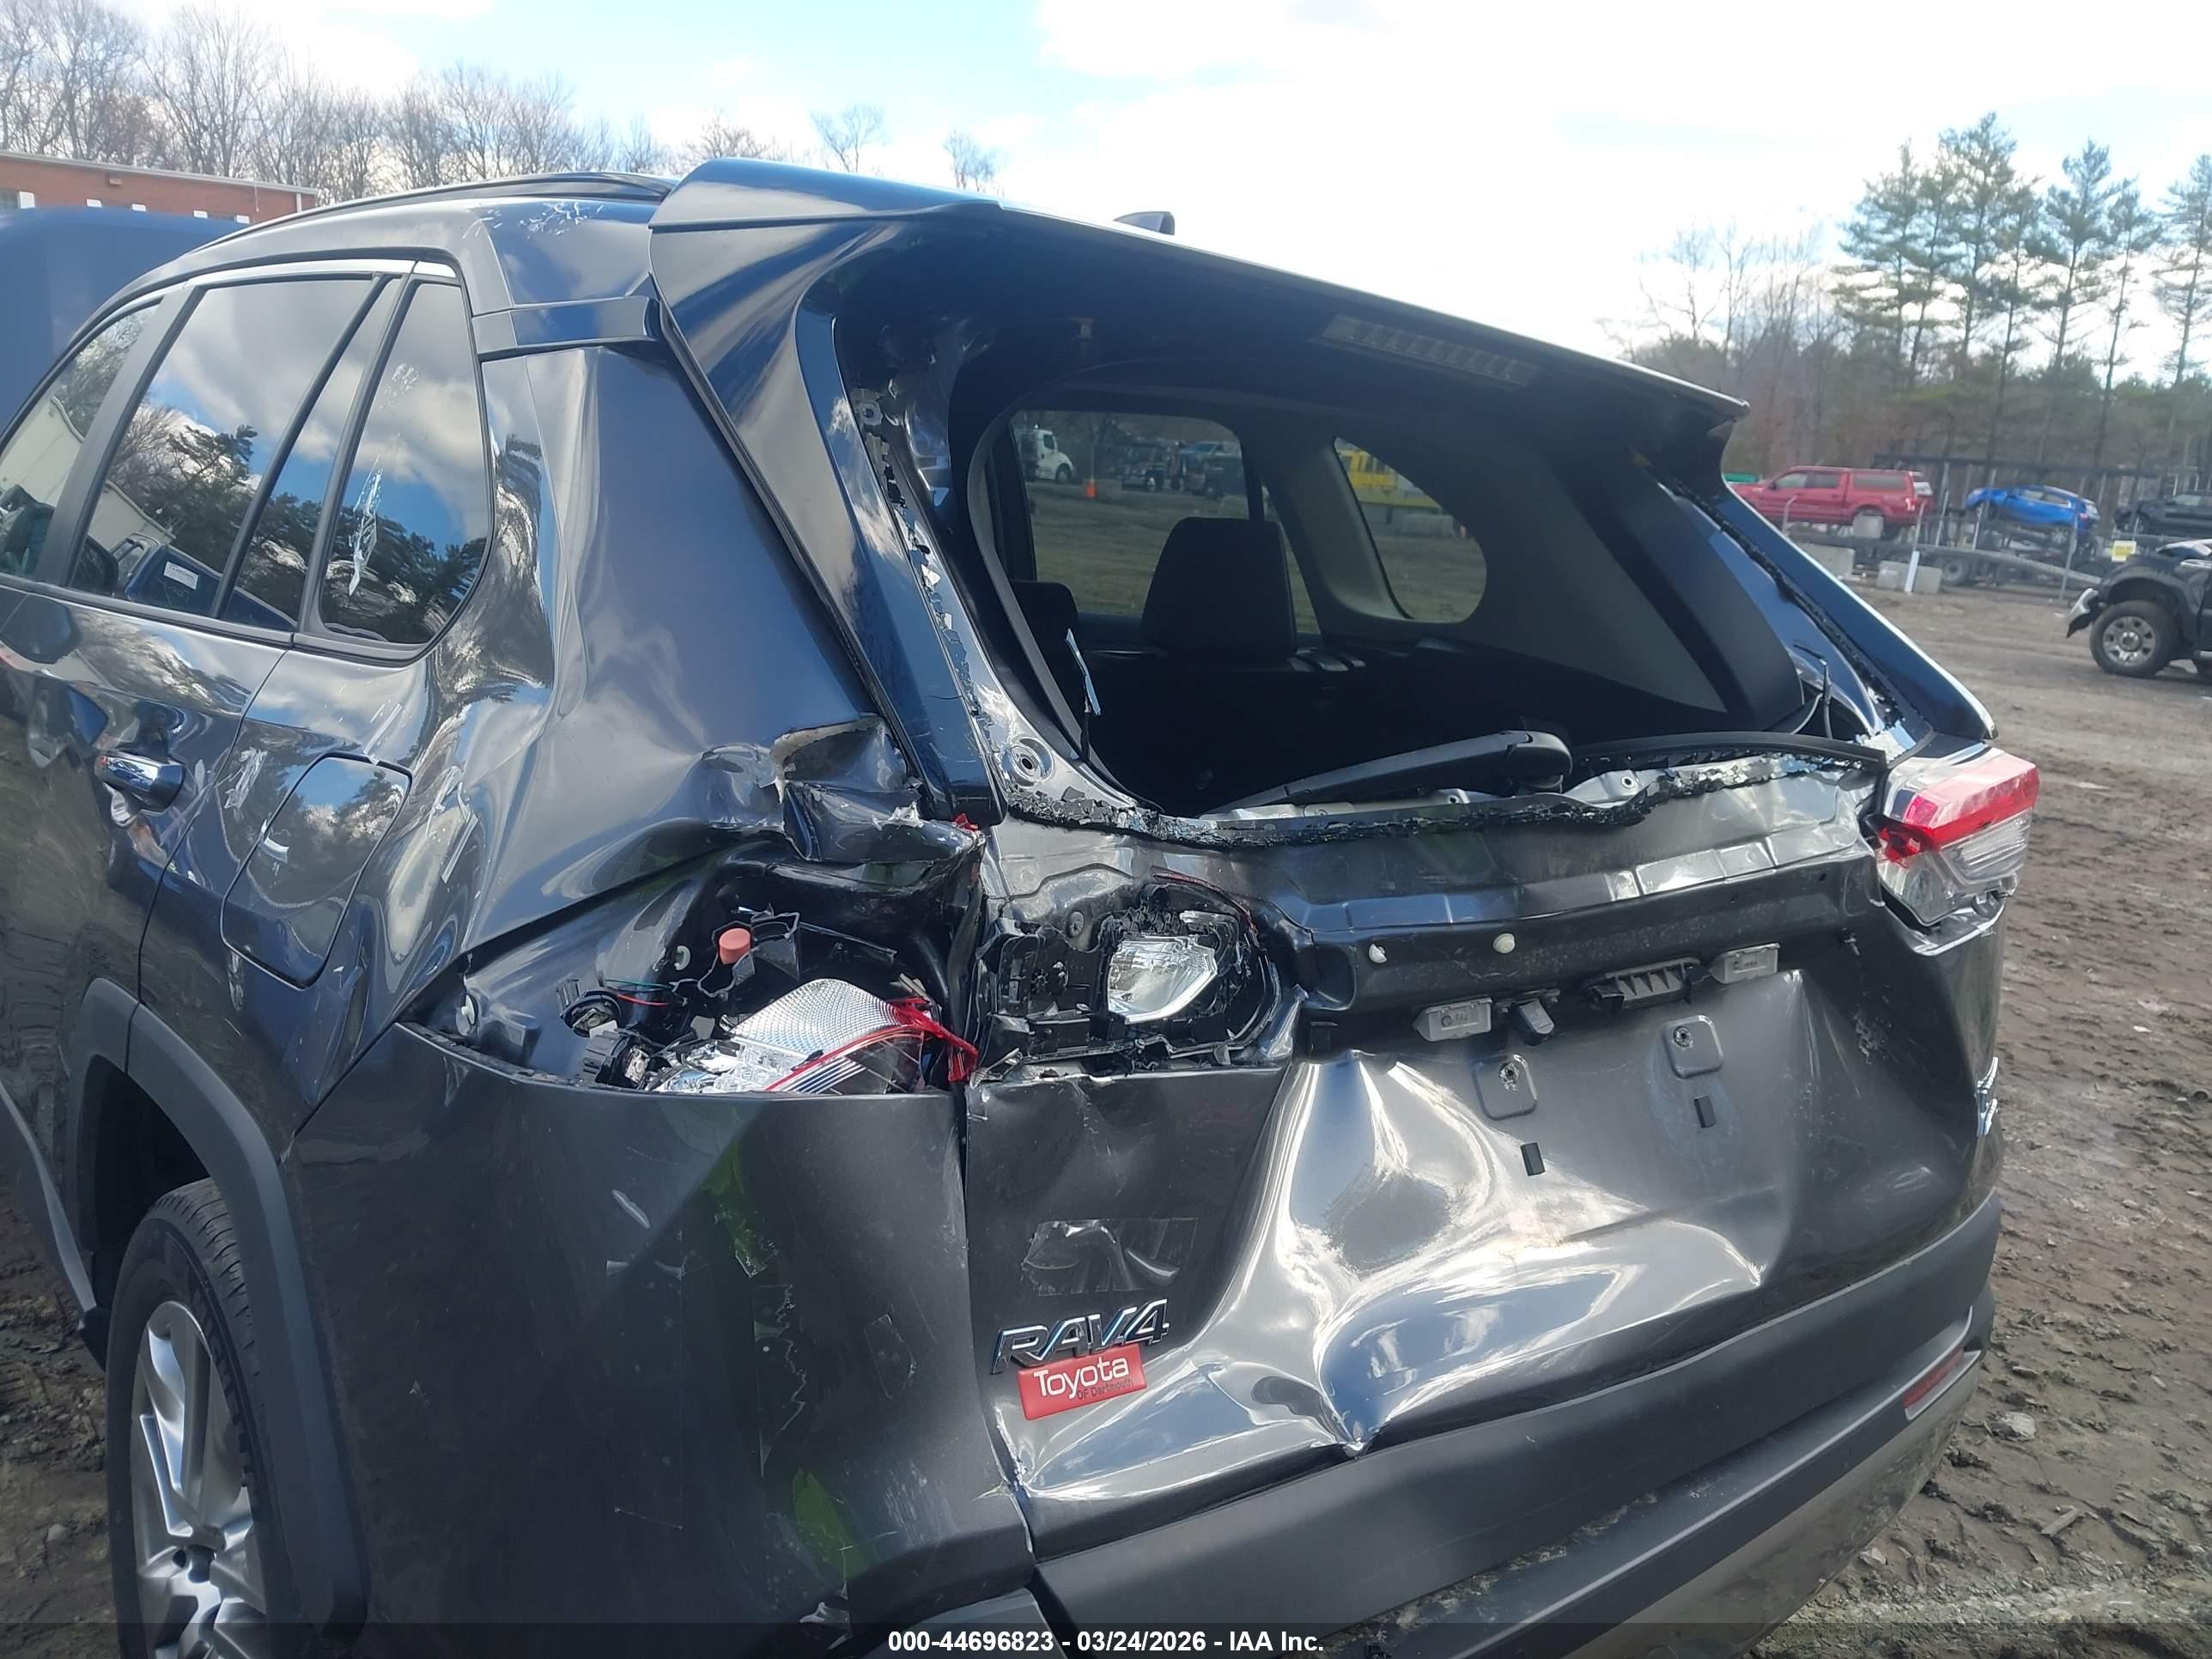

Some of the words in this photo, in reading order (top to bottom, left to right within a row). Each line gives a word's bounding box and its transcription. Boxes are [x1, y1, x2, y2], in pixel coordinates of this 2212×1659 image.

[991, 1297, 1170, 1375] RAV4
[1033, 1357, 1130, 1399] Toyota
[1092, 1378, 1133, 1397] Dartmouth
